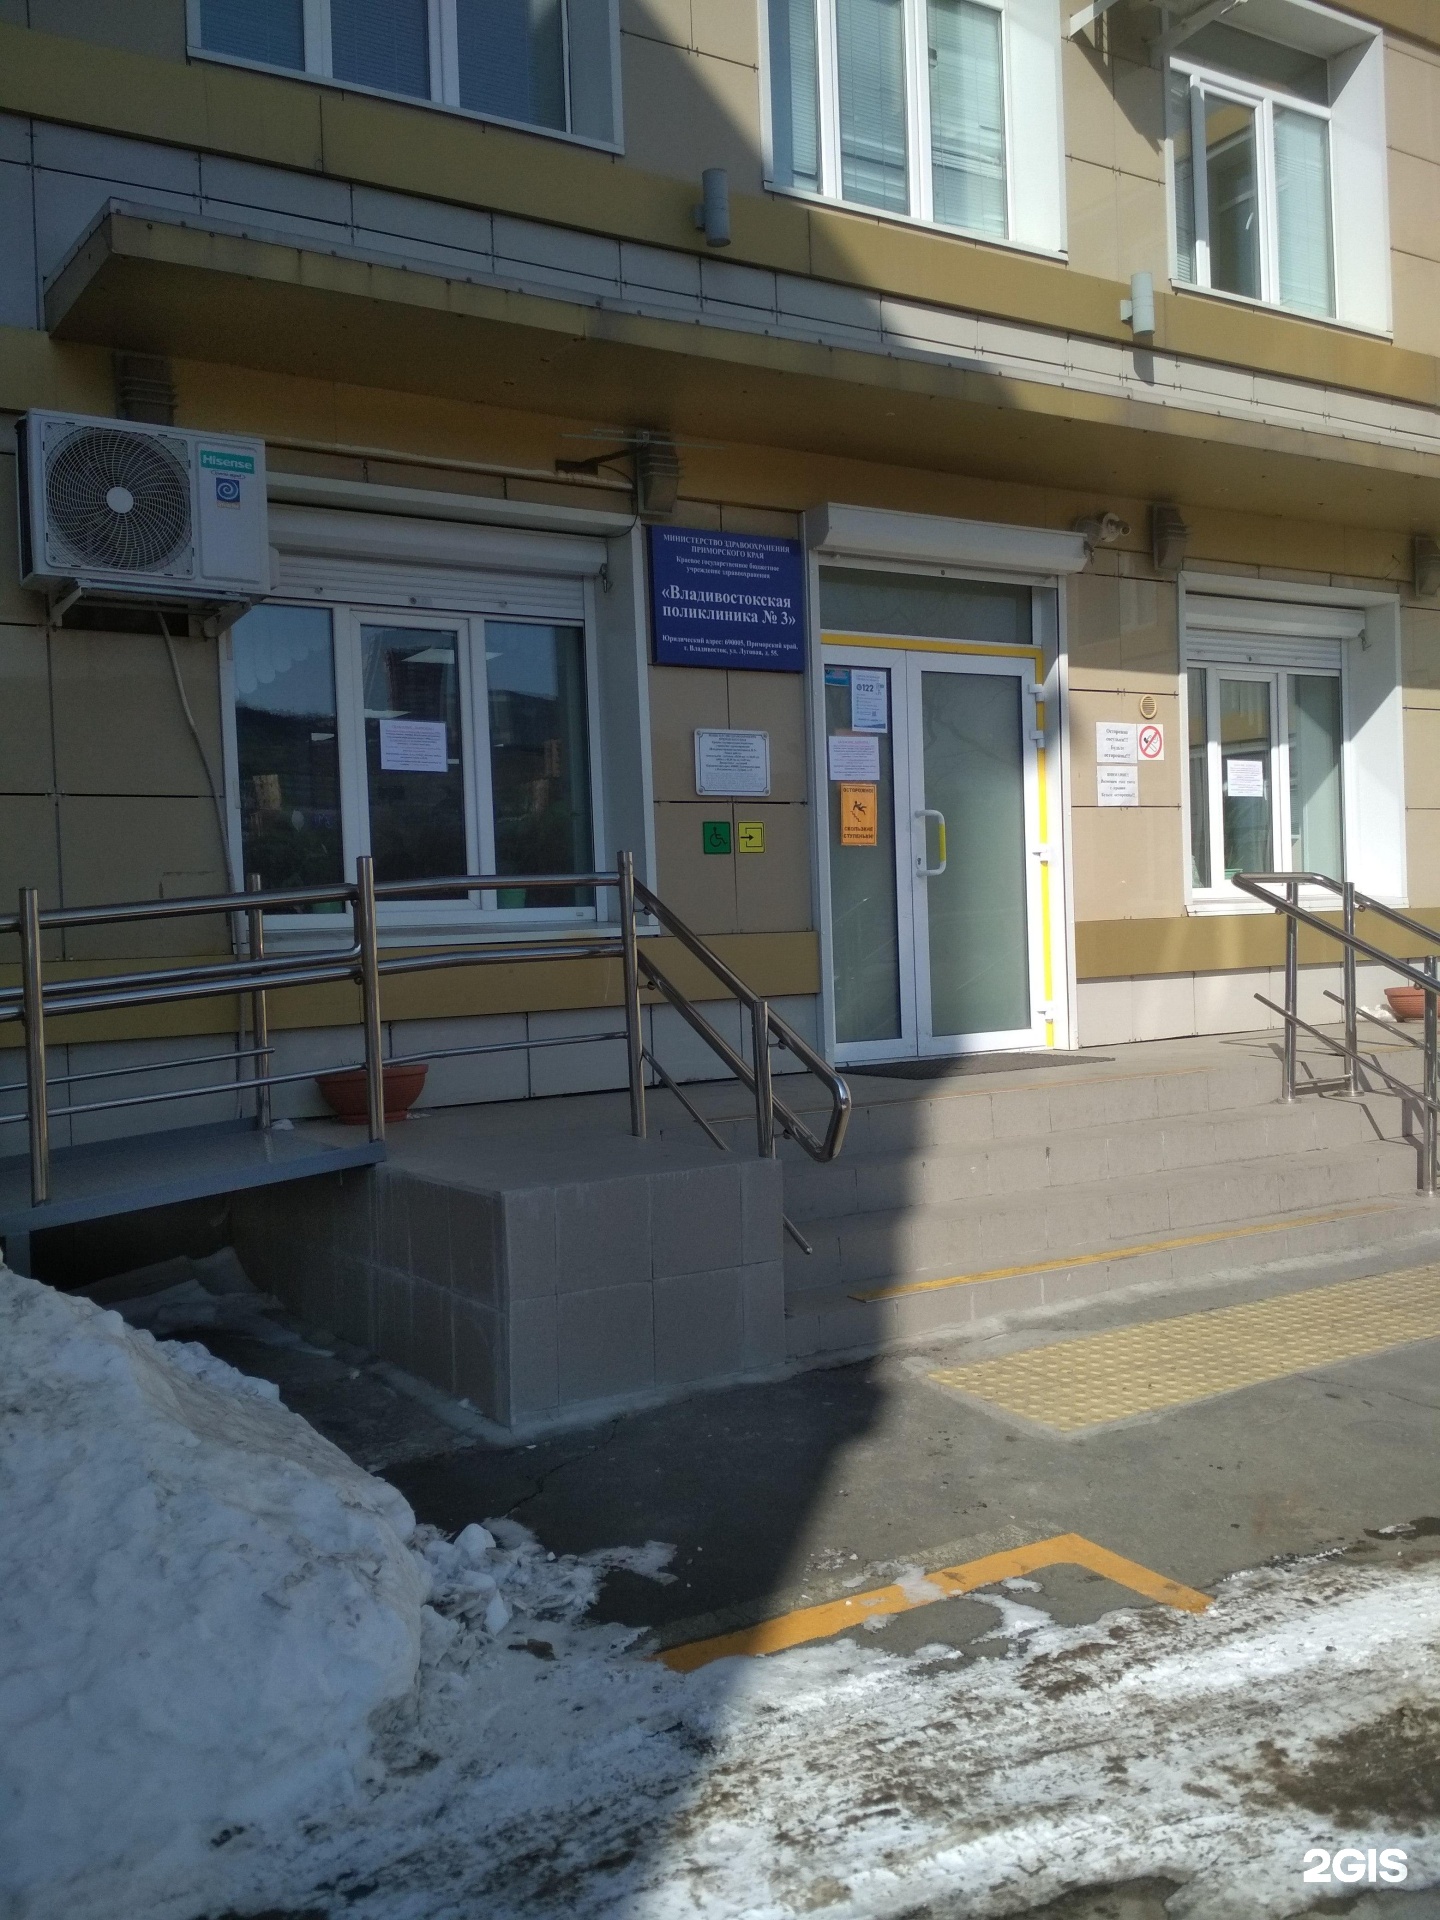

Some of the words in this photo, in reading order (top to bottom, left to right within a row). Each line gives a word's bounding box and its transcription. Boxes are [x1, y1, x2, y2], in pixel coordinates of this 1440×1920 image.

[202, 454, 253, 470] Hisense
[663, 533, 723, 547] МИНИСТЕРСТВО
[724, 540, 790, 553] ЗДРАВООХРАНЕНИЯ
[691, 545, 746, 558] ПРИМОРСКОГО
[747, 551, 764, 560] КРАЯ
[661, 584, 791, 609] «Владивостокская
[662, 605, 758, 623] поликлиника
[761, 609, 778, 624] №
[780, 611, 796, 626] 3»
[862, 683, 874, 692] 122
